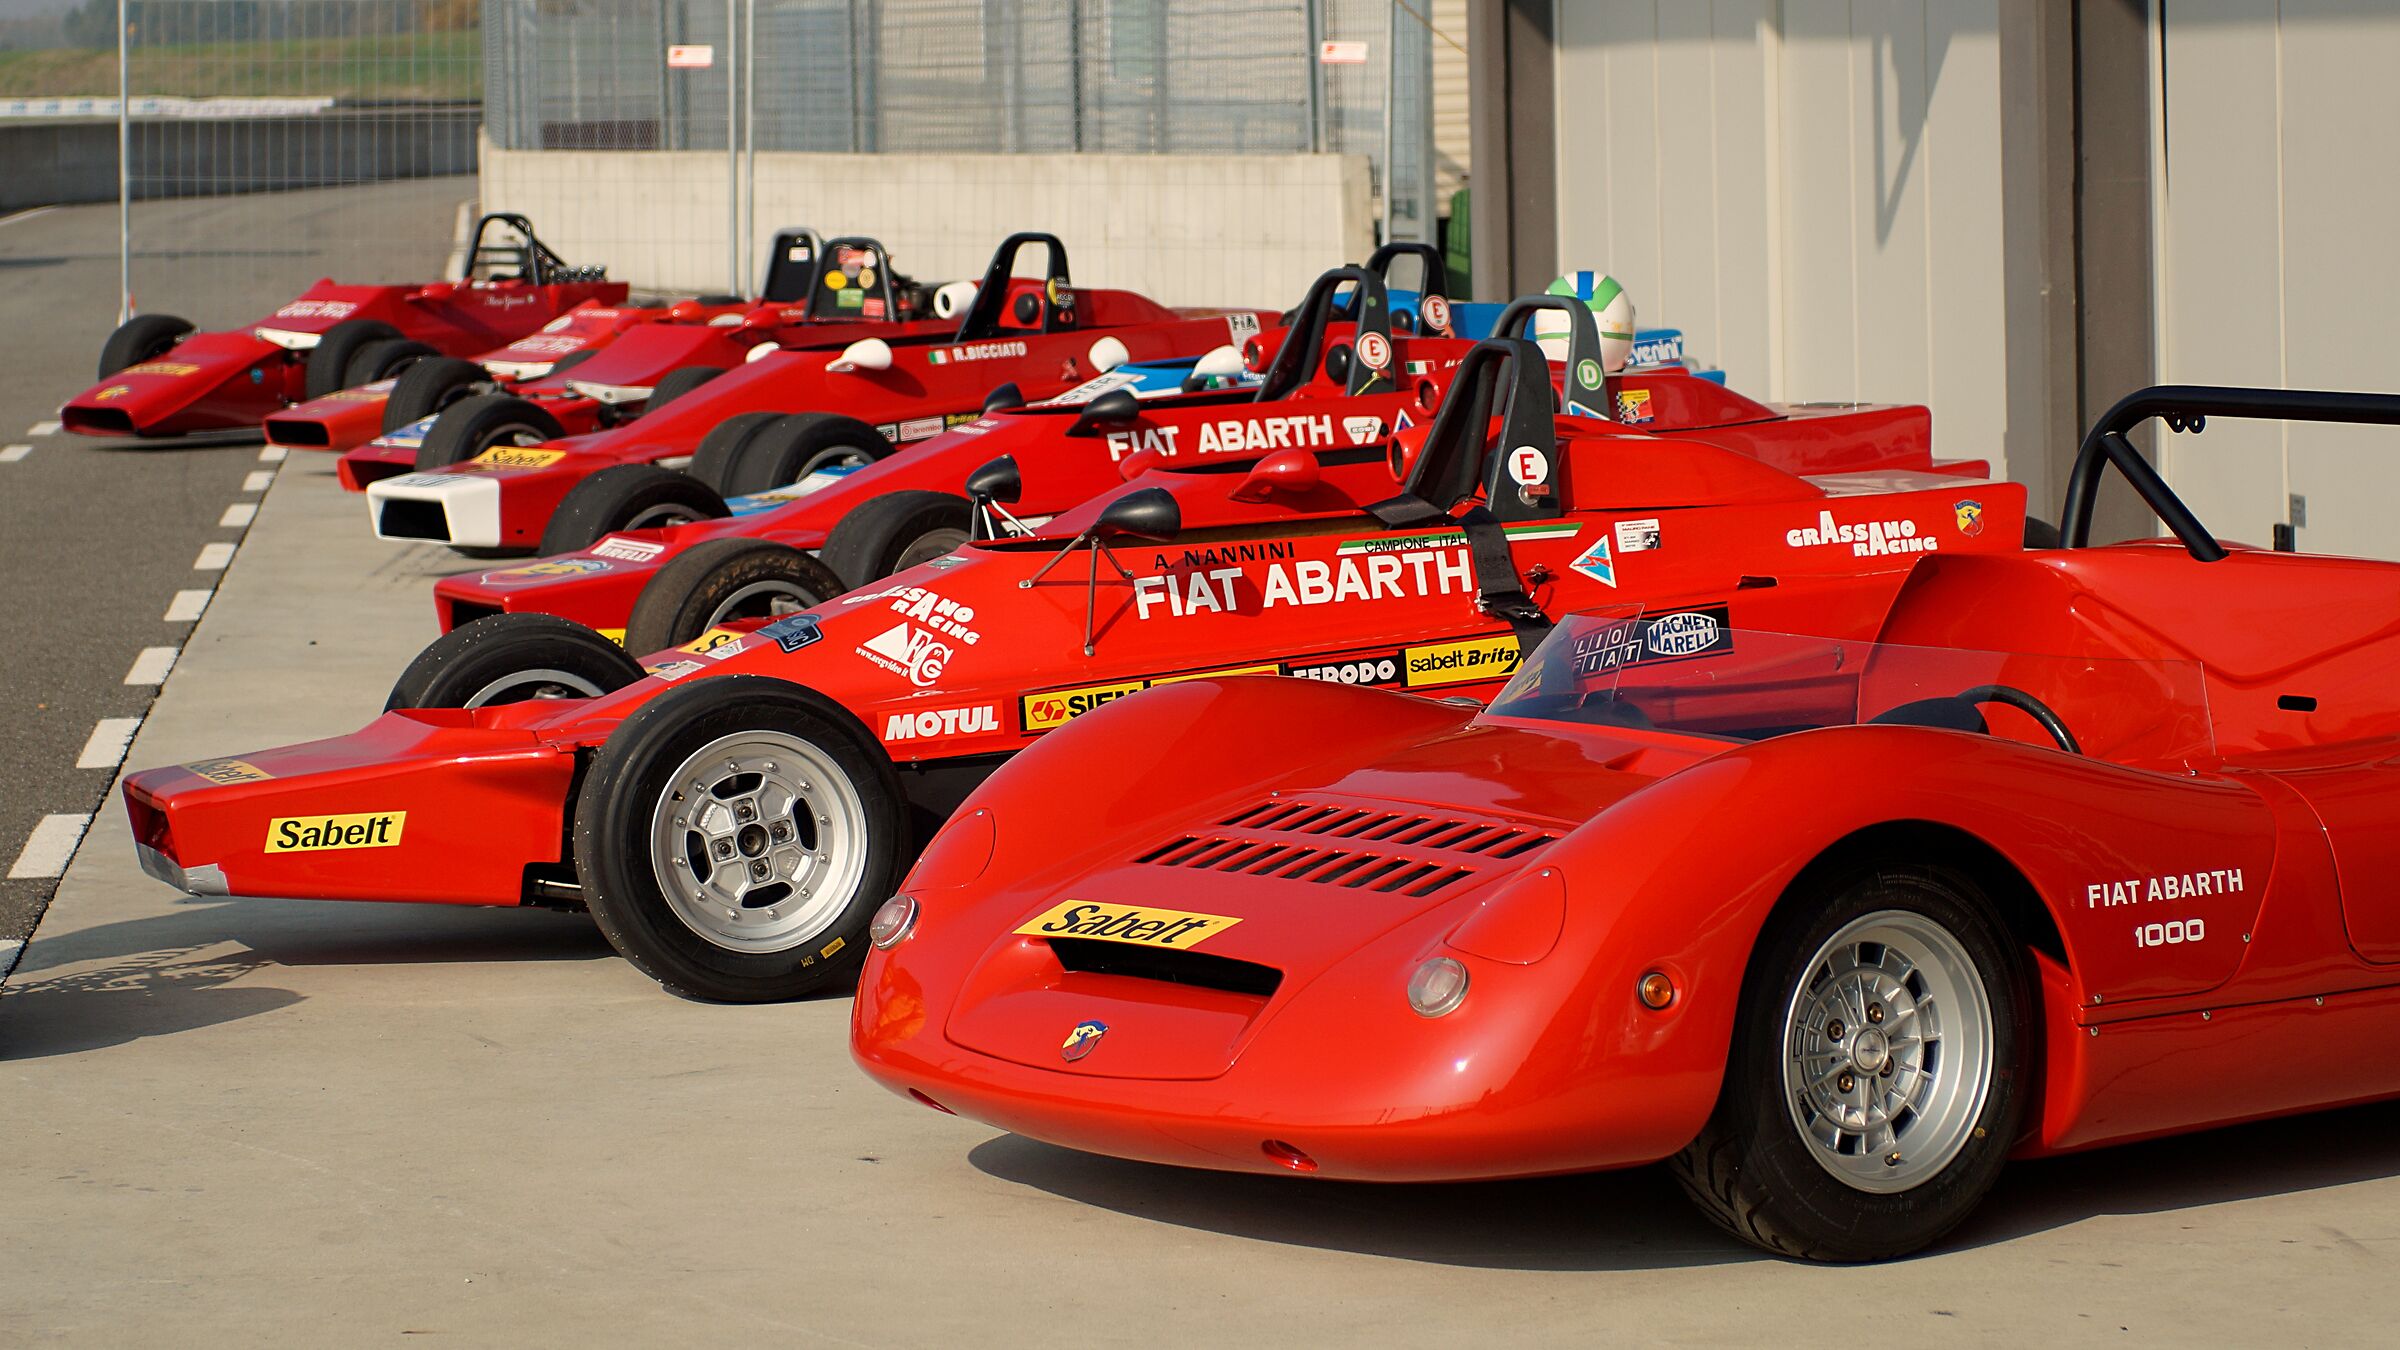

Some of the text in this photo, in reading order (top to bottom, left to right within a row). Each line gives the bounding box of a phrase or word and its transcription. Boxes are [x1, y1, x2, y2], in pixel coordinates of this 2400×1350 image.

[1231, 315, 1258, 331] FIA
[1432, 302, 1443, 318] E
[952, 341, 1027, 361] R.BICCIATO
[1369, 340, 1380, 356] E
[1582, 365, 1598, 384] D
[1107, 414, 1334, 461] FIAT ABARTH
[484, 450, 552, 466] Sabelt
[1520, 453, 1537, 479] E
[1786, 510, 1916, 548] GRASSANO
[1853, 524, 1938, 557] RACING
[591, 538, 664, 562] PIRELLI
[1154, 542, 1295, 570] A. NANNINI
[1364, 537, 1430, 553] CAMPIONE
[1134, 549, 1472, 620] FIAT ABARTH
[890, 599, 980, 645] RACING
[1649, 616, 1718, 641] MAGNETI
[1649, 627, 1718, 653] MARELLI
[1410, 650, 1464, 673] sabelt
[885, 706, 999, 741] MOTUL
[276, 816, 393, 849] Sabelt
[2087, 868, 2244, 908] FIAT ABARTH
[1042, 905, 1207, 944] Sabelt
[2135, 918, 2205, 948] 1000
